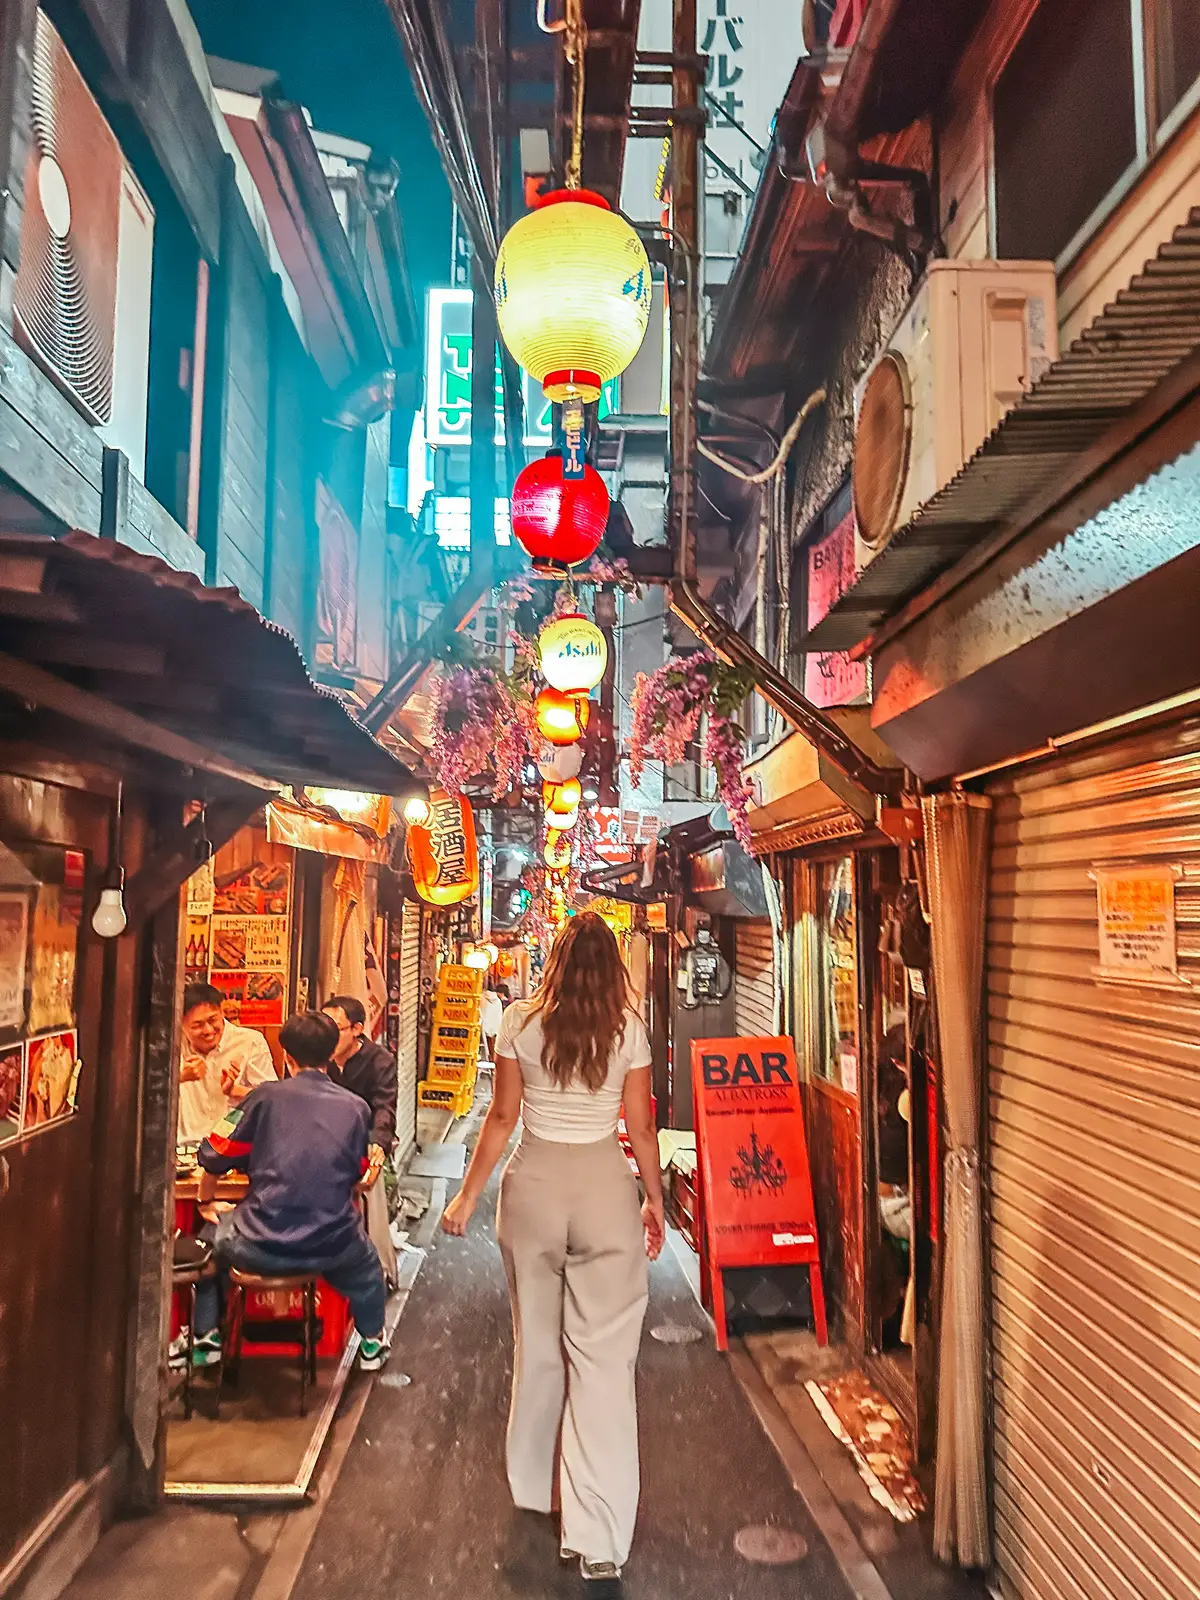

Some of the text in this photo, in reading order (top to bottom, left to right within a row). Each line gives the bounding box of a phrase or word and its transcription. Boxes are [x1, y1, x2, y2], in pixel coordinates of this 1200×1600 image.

[558, 641, 601, 657] Asahi
[430, 799, 471, 887] 居酒屋
[446, 980, 472, 990] KIRIN
[443, 1009, 469, 1019] KIRIN
[439, 1038, 466, 1049] KIRIN
[435, 1068, 462, 1078] KIRIN
[701, 1052, 793, 1086] BAR
